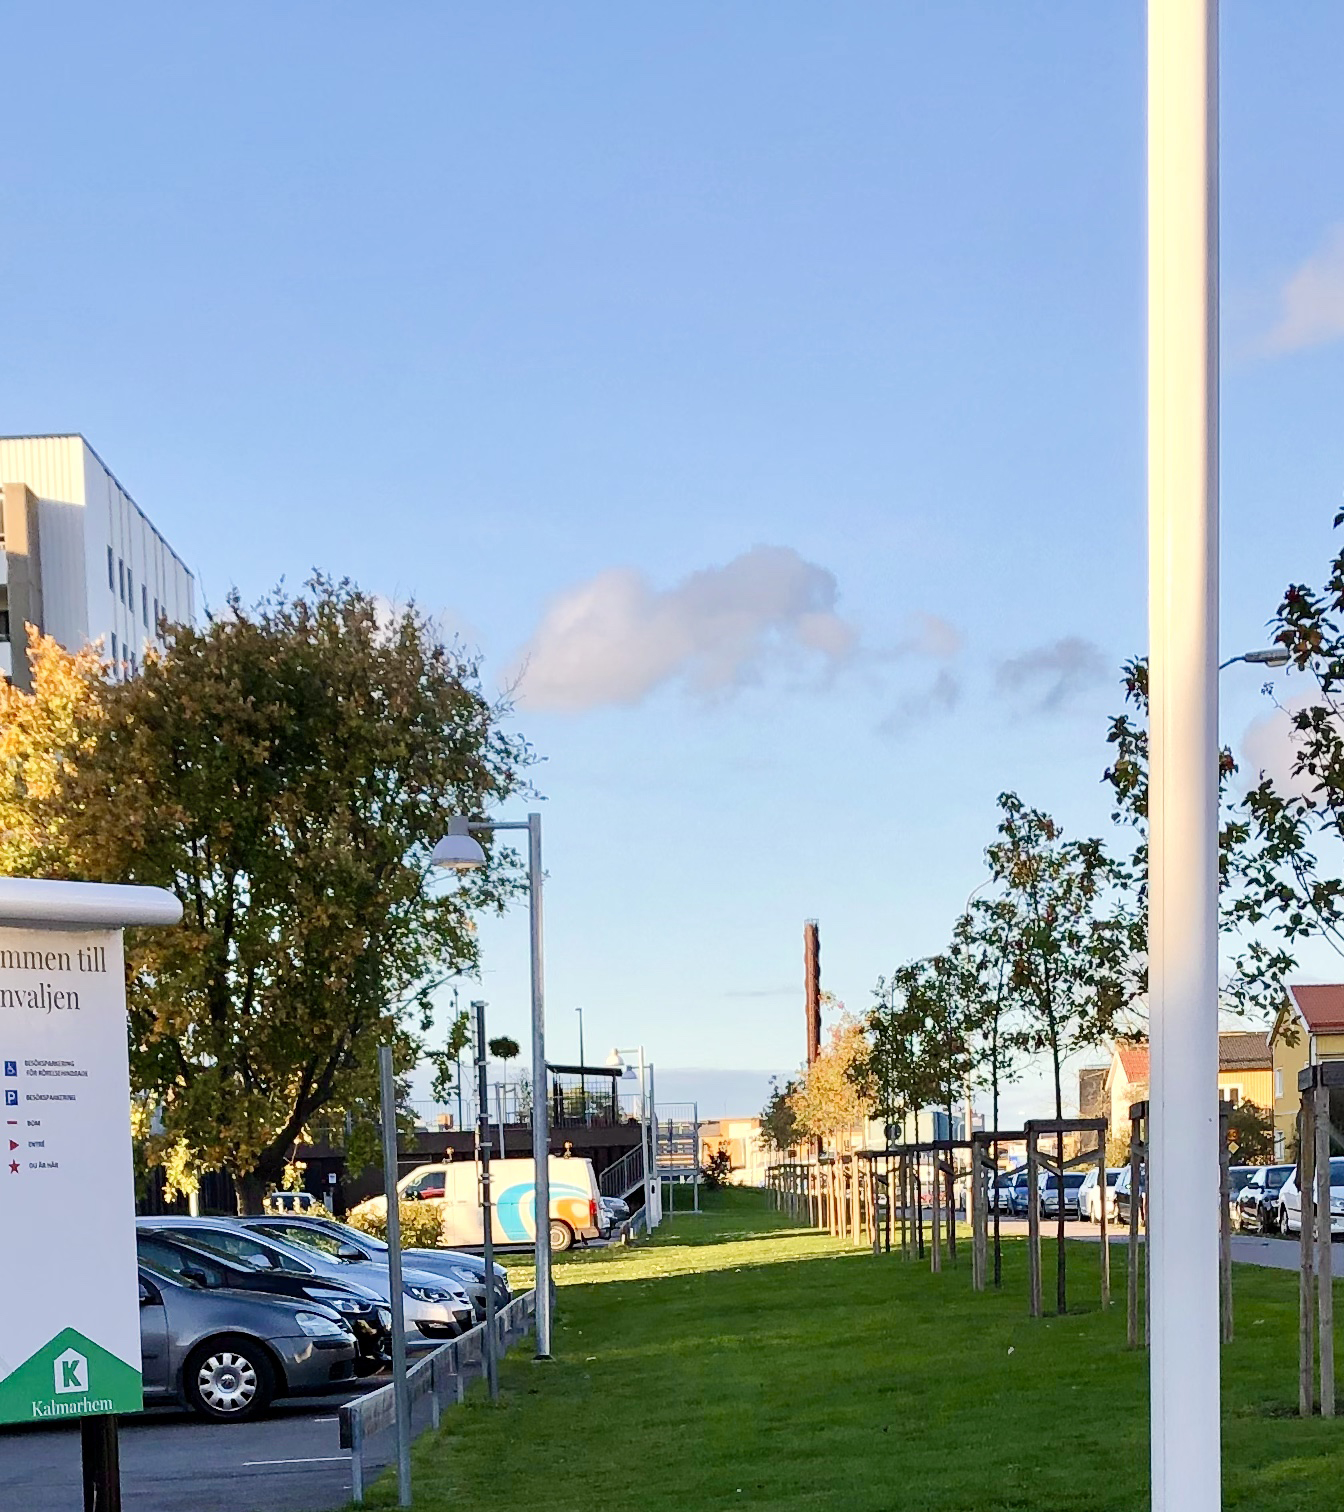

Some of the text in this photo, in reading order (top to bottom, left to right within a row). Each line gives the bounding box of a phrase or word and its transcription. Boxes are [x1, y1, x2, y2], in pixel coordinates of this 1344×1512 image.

[77, 946, 107, 973] till
[62, 1360, 82, 1388] K
[32, 1397, 113, 1416] Kalmarhem
